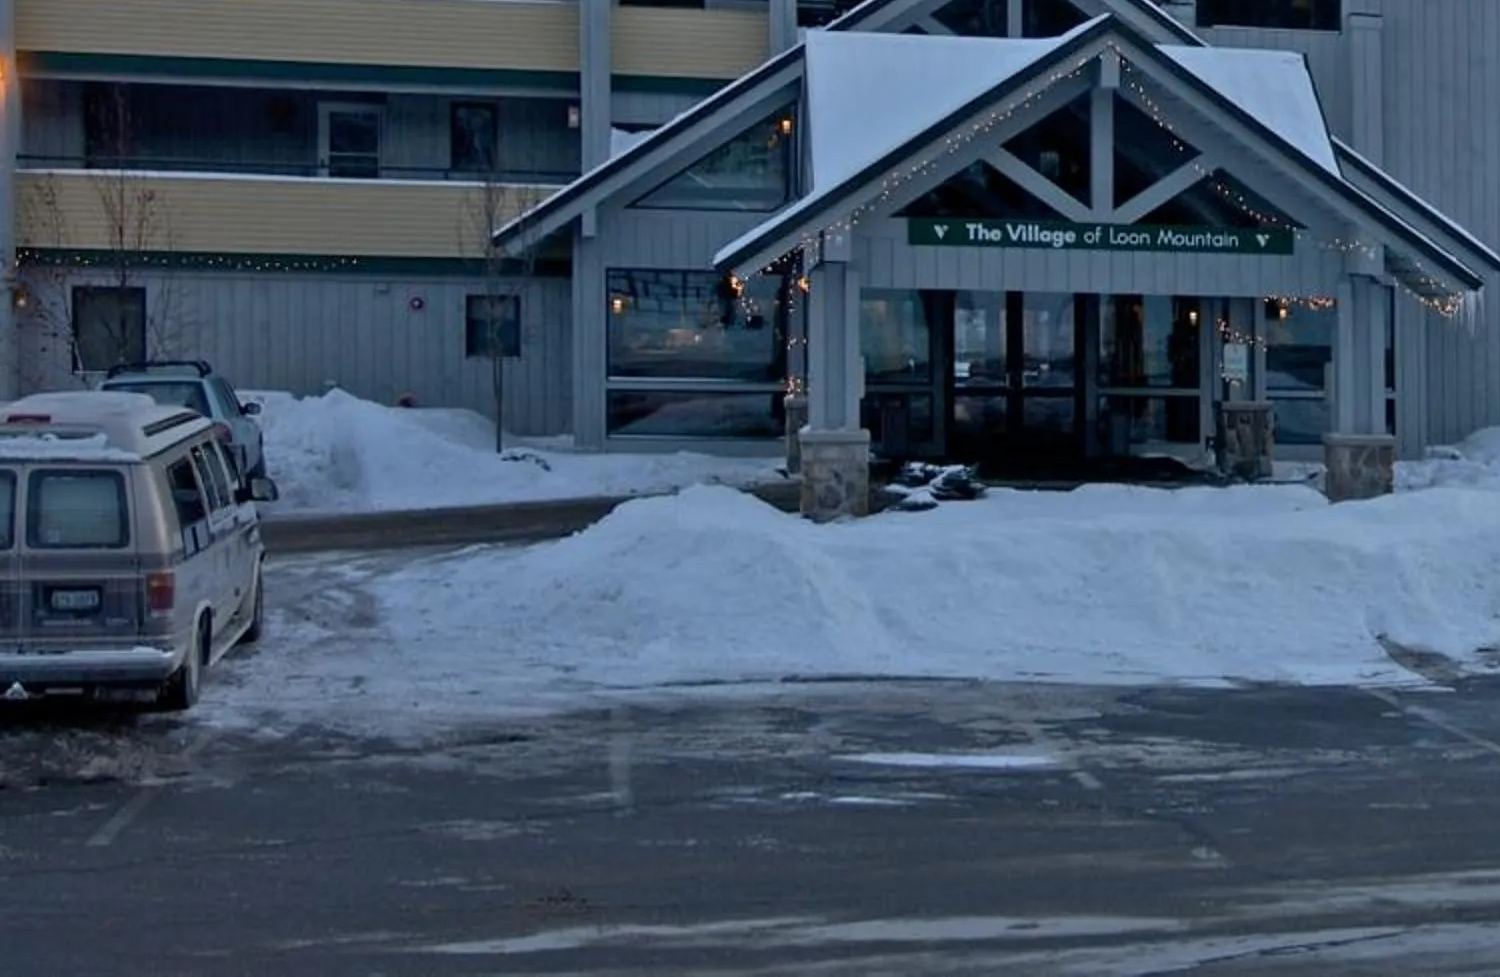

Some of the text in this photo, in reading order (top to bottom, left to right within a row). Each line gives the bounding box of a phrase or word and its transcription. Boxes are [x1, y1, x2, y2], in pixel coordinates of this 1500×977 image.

[965, 223, 1239, 247] The Village of Loon Mountain
